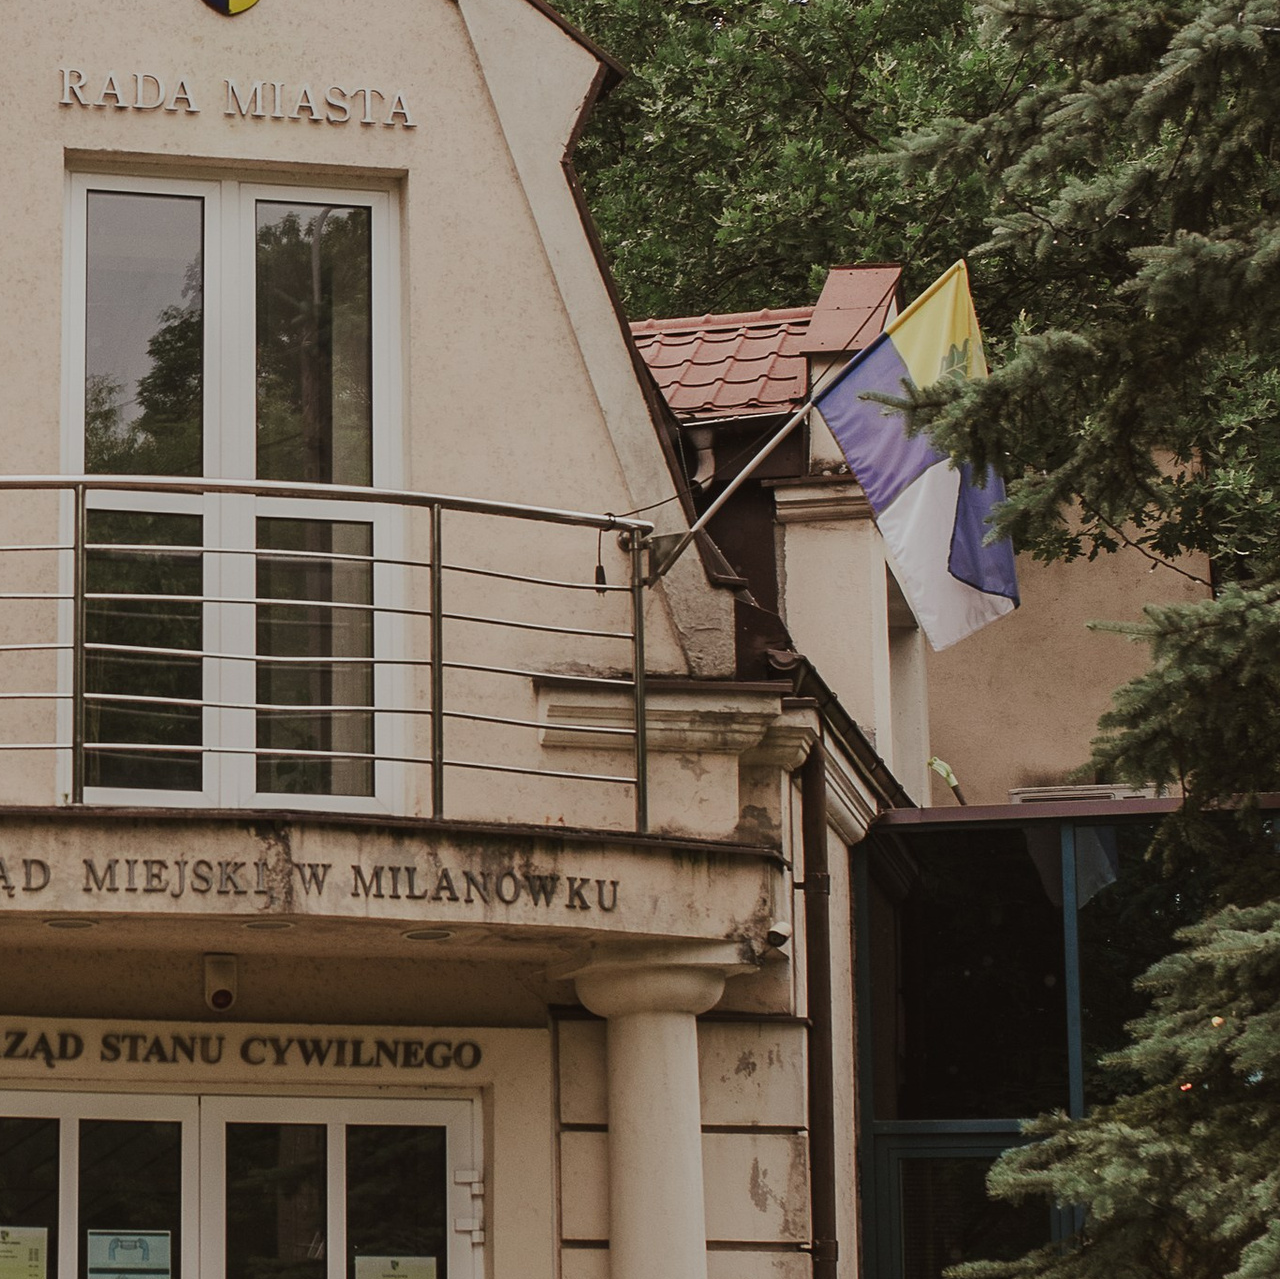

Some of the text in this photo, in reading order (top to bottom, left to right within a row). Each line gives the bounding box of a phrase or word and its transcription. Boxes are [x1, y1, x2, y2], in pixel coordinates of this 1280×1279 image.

[58, 67, 418, 128] RADA MIASTA
[81, 858, 270, 899] MIEJSKI
[295, 862, 333, 896] W
[350, 863, 620, 913] MILANÓWKU
[99, 1033, 226, 1065] STANU
[239, 1035, 483, 1071] CYWILNEGO
